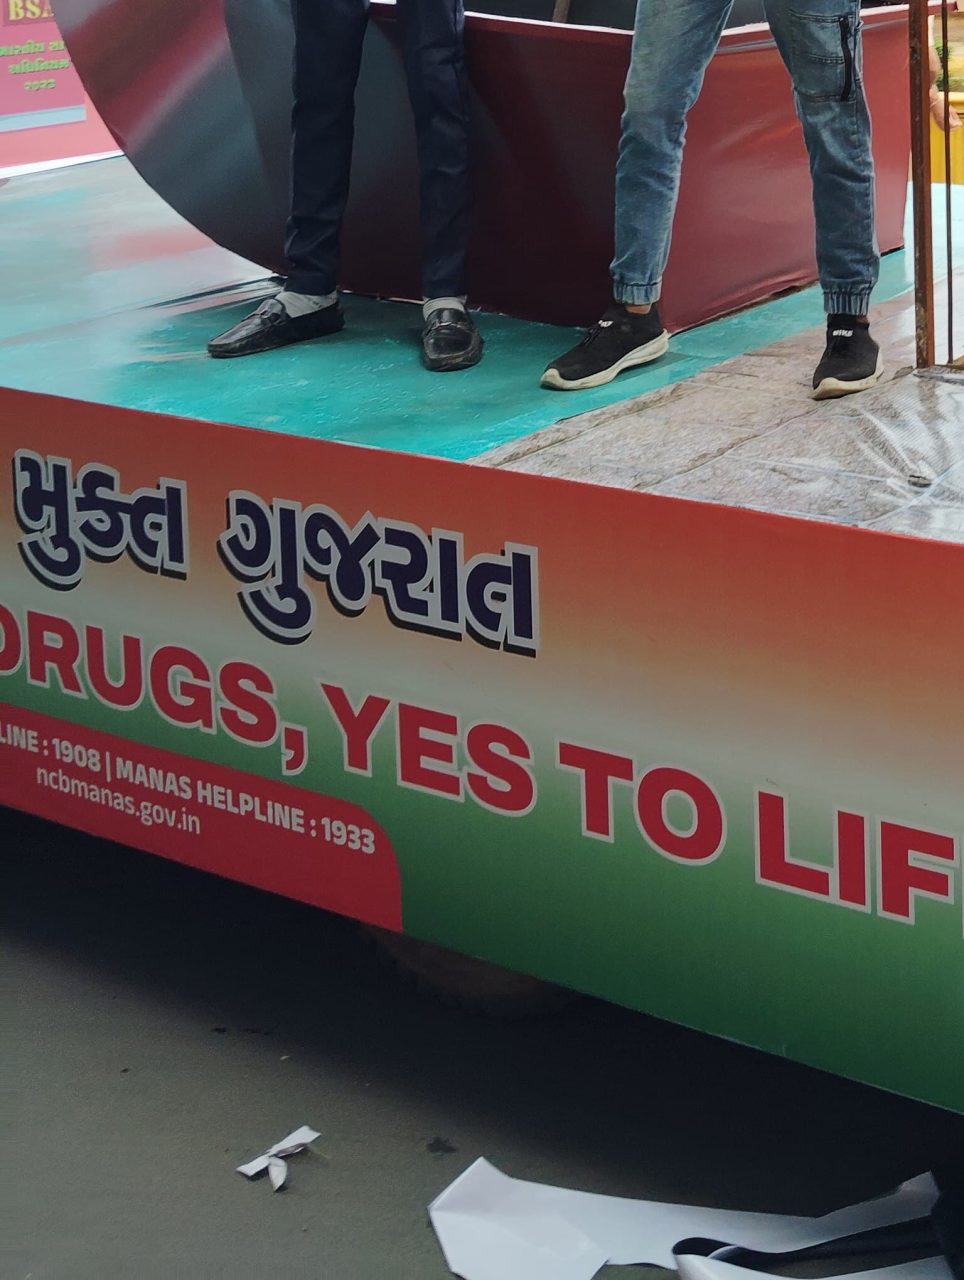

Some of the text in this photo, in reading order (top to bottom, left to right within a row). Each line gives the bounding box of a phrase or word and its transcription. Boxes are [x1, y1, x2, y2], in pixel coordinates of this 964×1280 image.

[13, 448, 539, 658] મુક્ત ગુજરાત
[36, 765, 201, 834] ncbmanas.gov.in
[51, 737, 101, 771] 1908
[115, 756, 192, 800] MANAS
[196, 780, 305, 834] HELPLINE
[320, 816, 376, 854] 1933
[318, 681, 536, 818] YES
[555, 736, 727, 867] TO
